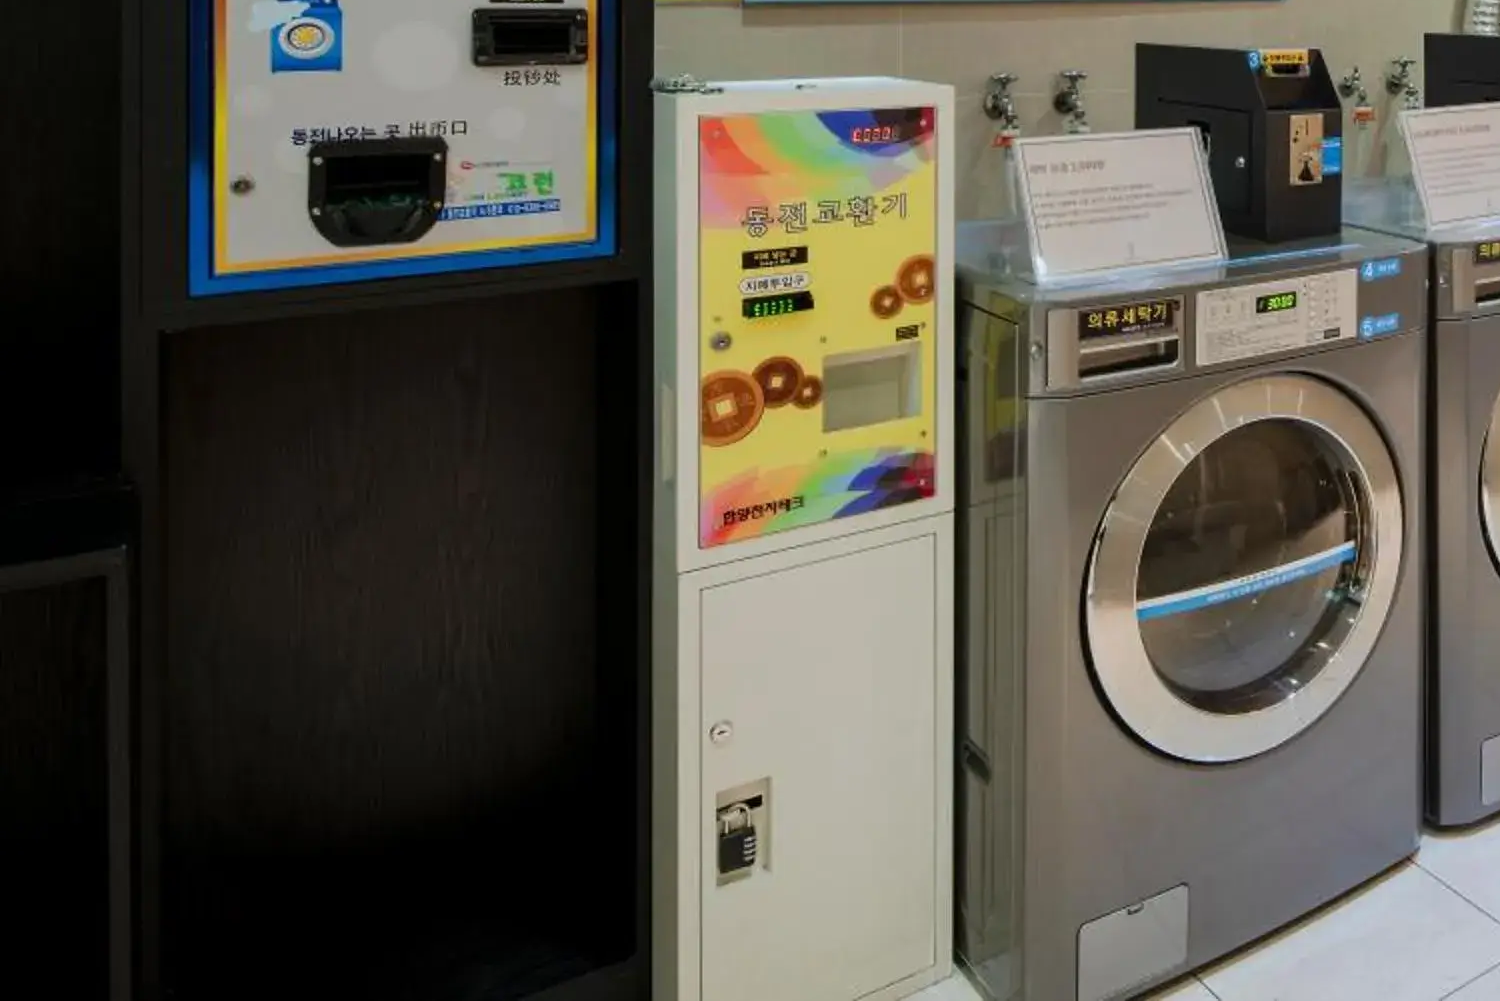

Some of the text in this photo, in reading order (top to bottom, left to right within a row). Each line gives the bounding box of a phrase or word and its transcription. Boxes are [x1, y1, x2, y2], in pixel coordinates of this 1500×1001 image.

[1249, 52, 1259, 67] 3
[741, 193, 908, 238] 동전교환기
[1087, 303, 1167, 328] 의류세탁기
